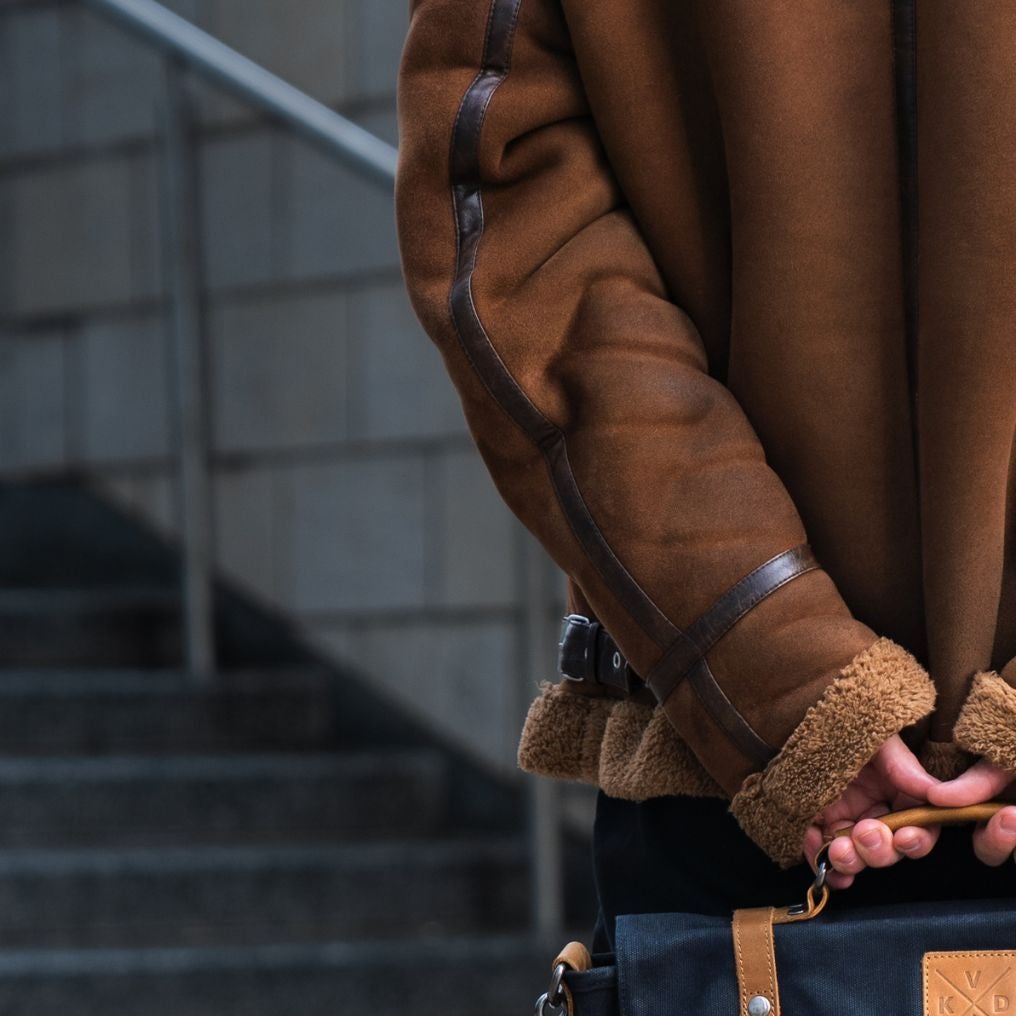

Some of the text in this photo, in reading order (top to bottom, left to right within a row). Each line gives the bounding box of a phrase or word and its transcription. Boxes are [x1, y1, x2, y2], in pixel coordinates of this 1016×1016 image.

[965, 970, 981, 989] V
[938, 996, 954, 1014] K
[993, 995, 1009, 1013] D
